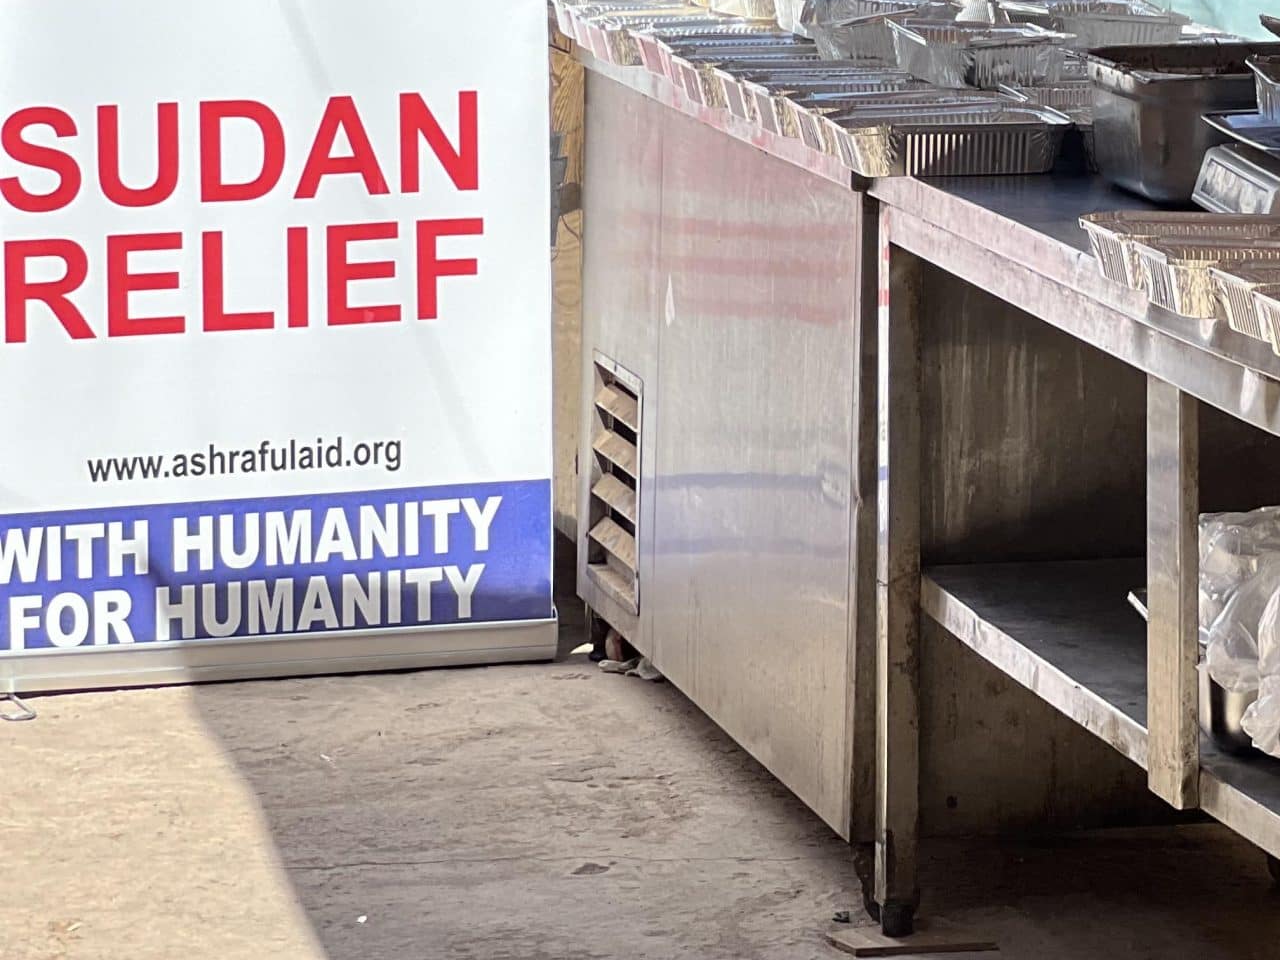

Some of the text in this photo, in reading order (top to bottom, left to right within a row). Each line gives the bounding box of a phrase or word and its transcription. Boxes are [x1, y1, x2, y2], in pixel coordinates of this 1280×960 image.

[0, 89, 480, 213] SUDAN
[4, 217, 484, 344] RELIEF
[87, 436, 402, 483] www.ashrafulaid.org
[0, 495, 503, 585] WITH HUMANITY
[9, 562, 486, 649] FOR HUMANITY
